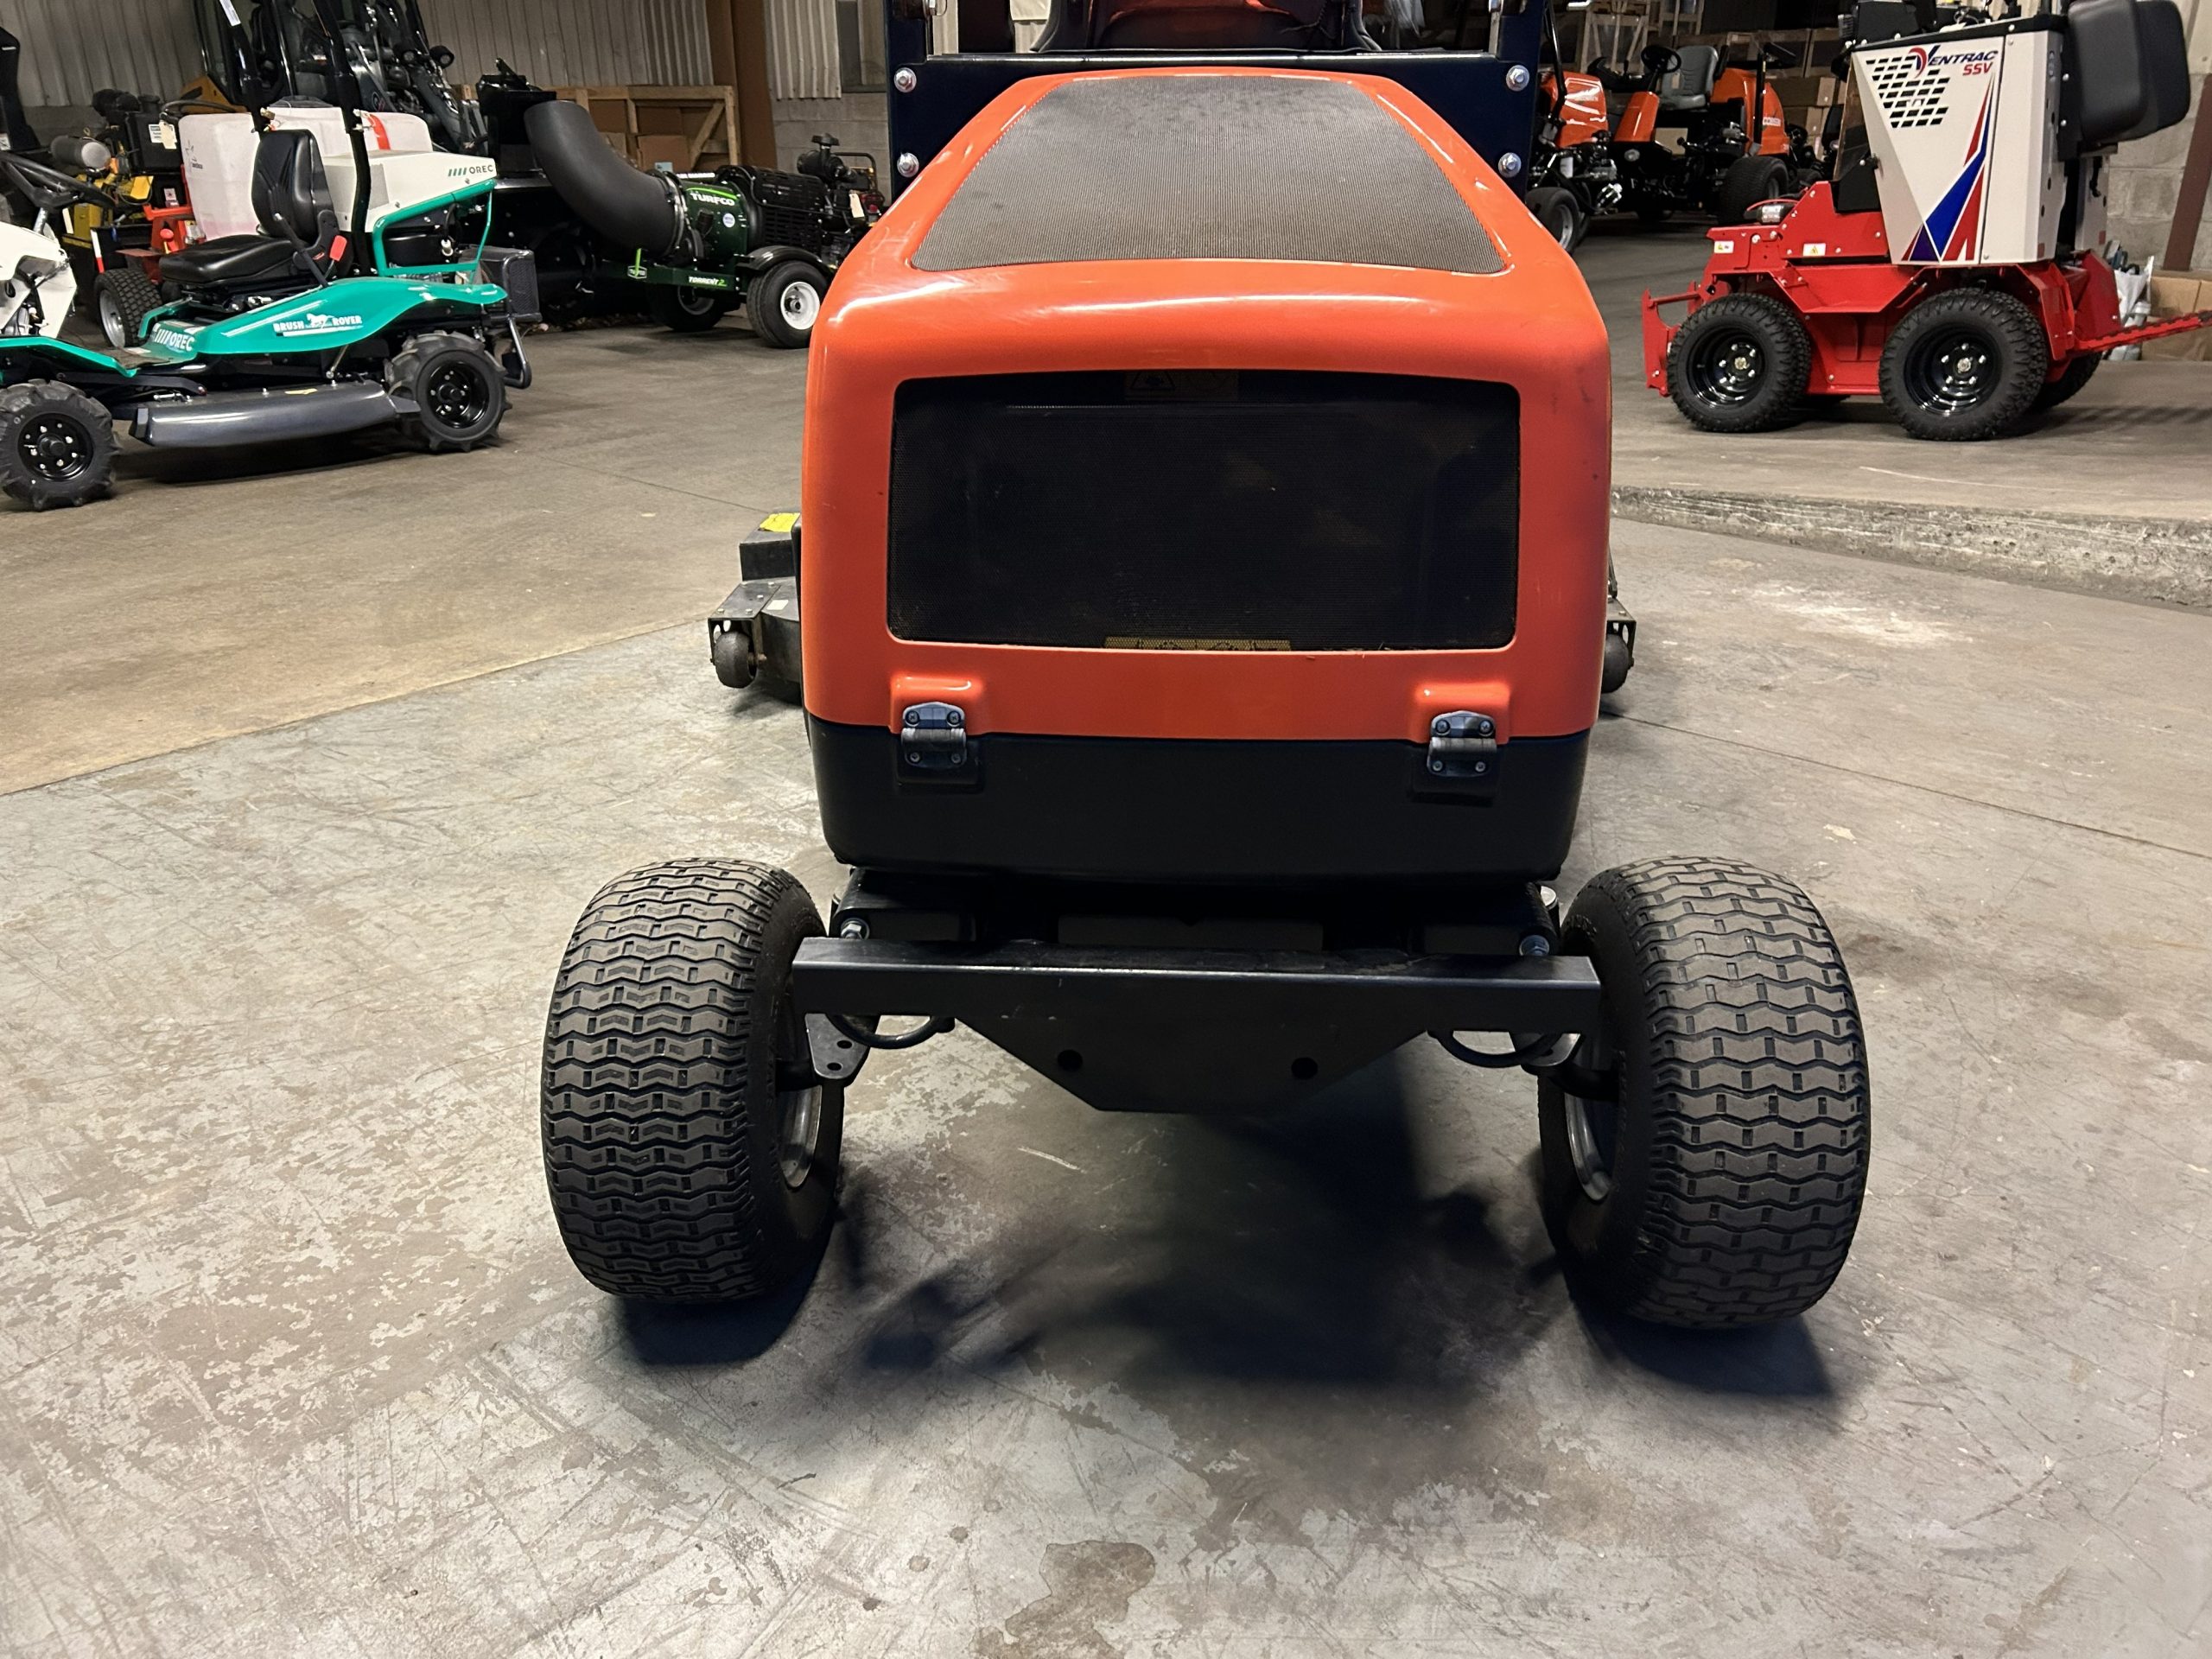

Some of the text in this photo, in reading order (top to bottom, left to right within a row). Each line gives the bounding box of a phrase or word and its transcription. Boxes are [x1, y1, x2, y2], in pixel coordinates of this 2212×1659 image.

[1908, 45, 1999, 74] VENTRAC
[1962, 61, 1993, 76] SSV
[468, 164, 493, 175] OREC
[690, 191, 735, 207] TURFCO
[272, 315, 362, 333] BRUSH ROVER
[170, 332, 195, 352] OREC
